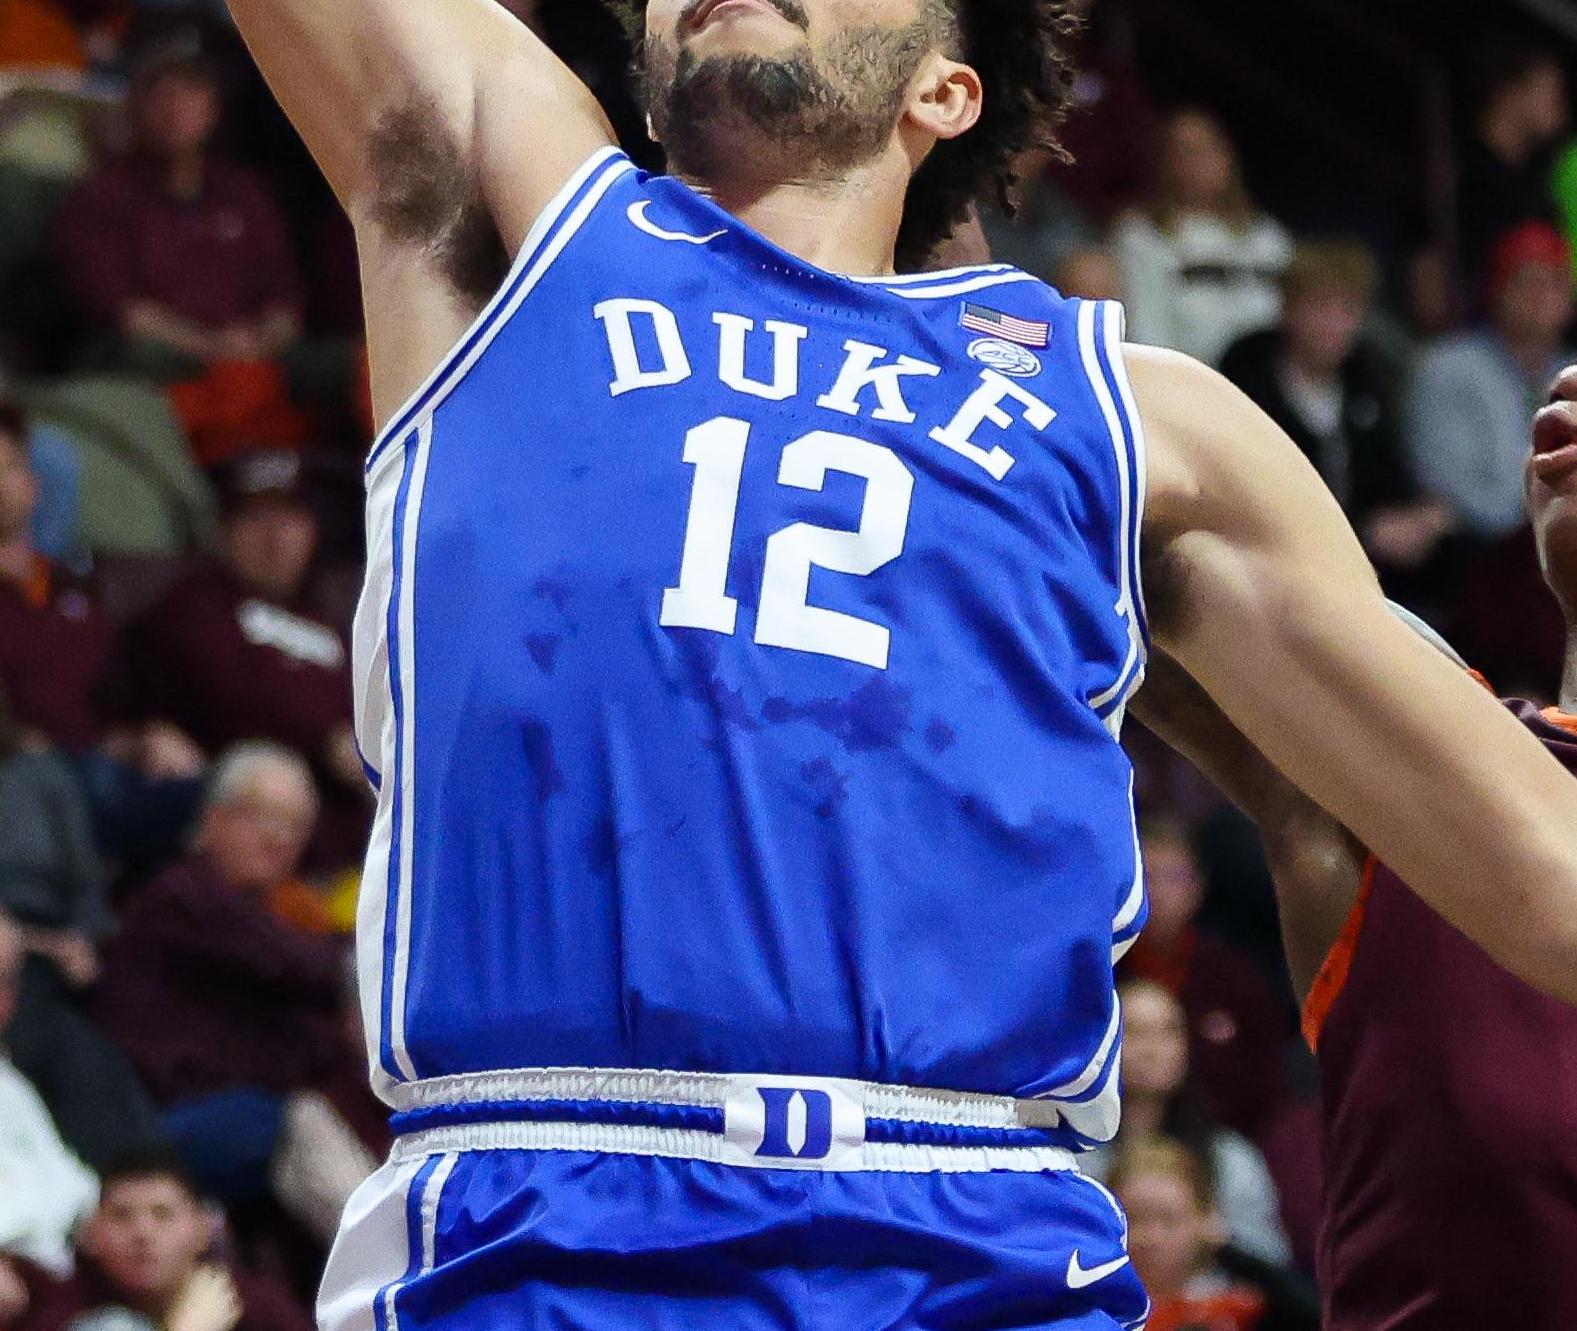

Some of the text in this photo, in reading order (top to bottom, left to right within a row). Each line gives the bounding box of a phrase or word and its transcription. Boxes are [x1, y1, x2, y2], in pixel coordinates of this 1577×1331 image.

[594, 298, 1058, 481] DUKE
[659, 416, 915, 670] 12
[755, 1088, 832, 1159] D
